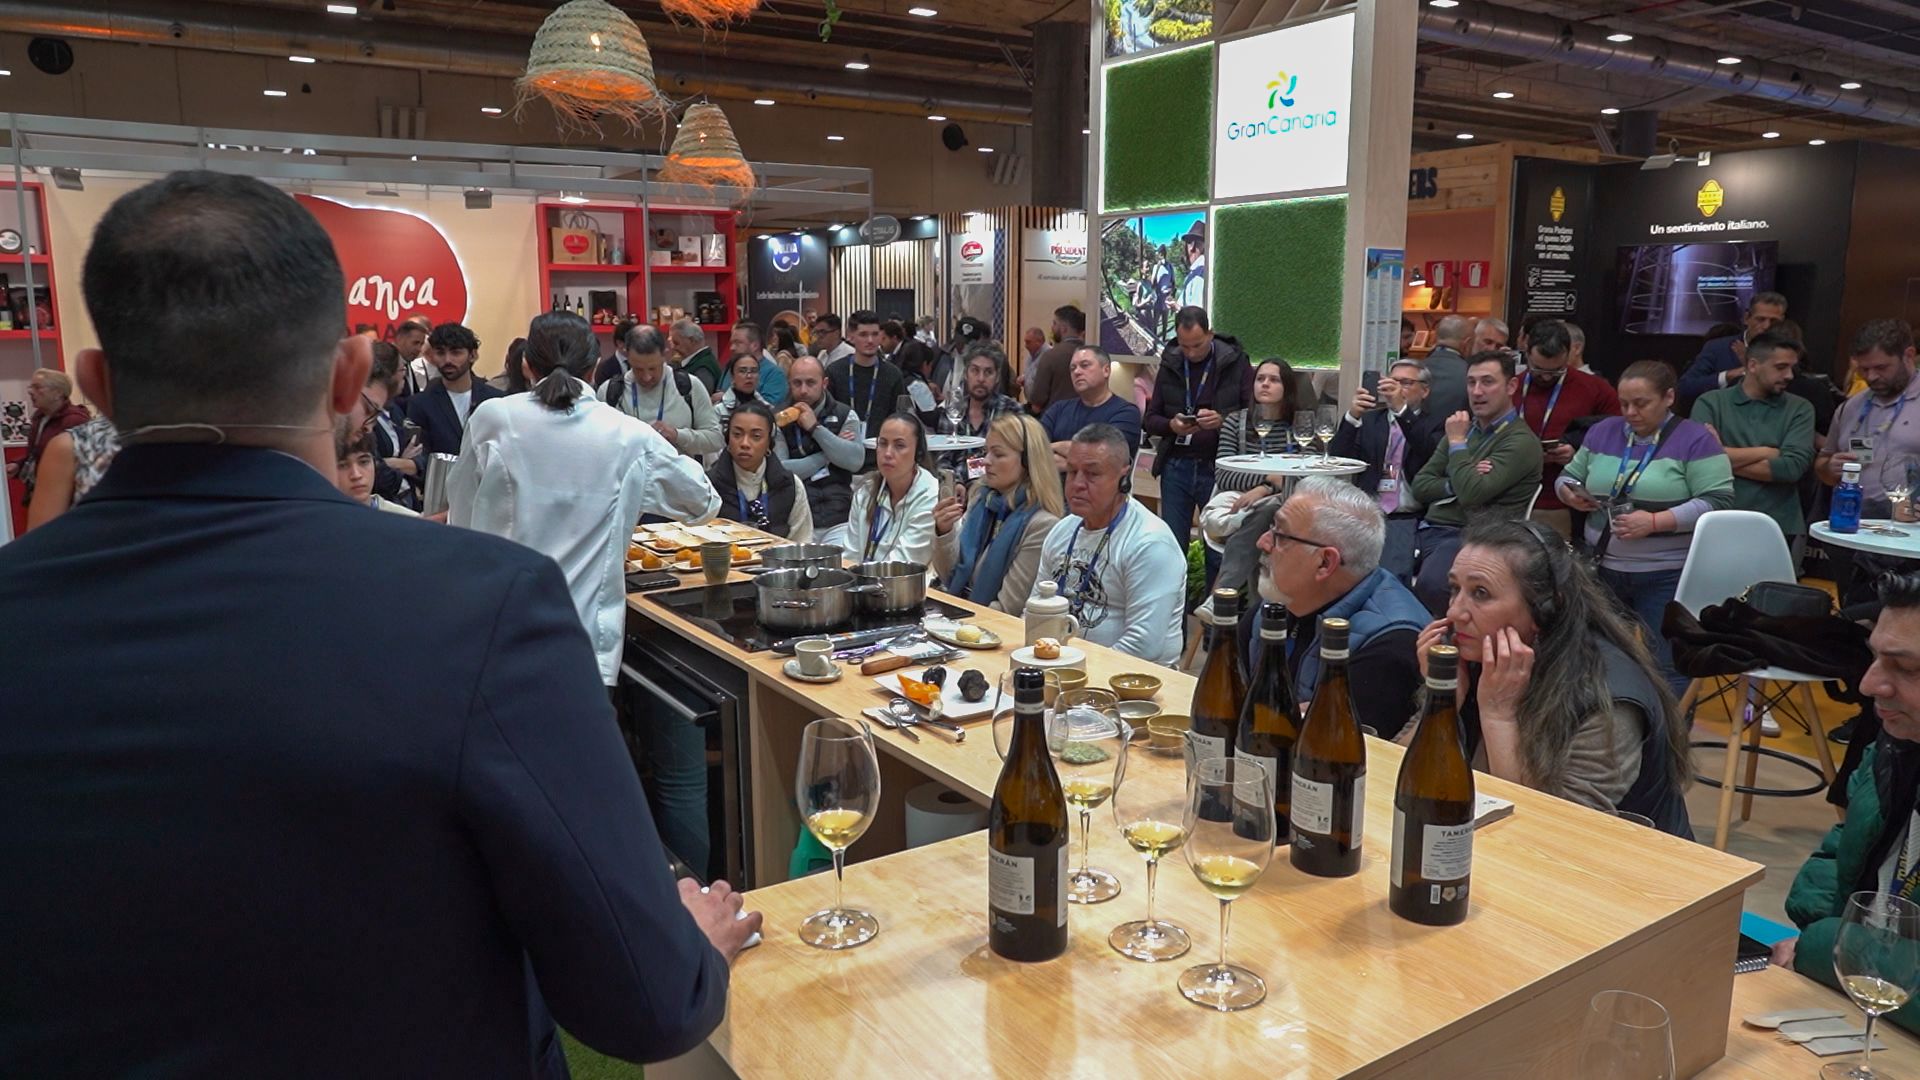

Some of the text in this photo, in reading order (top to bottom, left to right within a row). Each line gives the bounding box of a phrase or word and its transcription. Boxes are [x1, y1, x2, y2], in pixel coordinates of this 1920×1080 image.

[1408, 166, 1438, 200] ERS
[1650, 219, 1770, 235] Un sentimiento italiano.
[348, 275, 439, 321] anca
